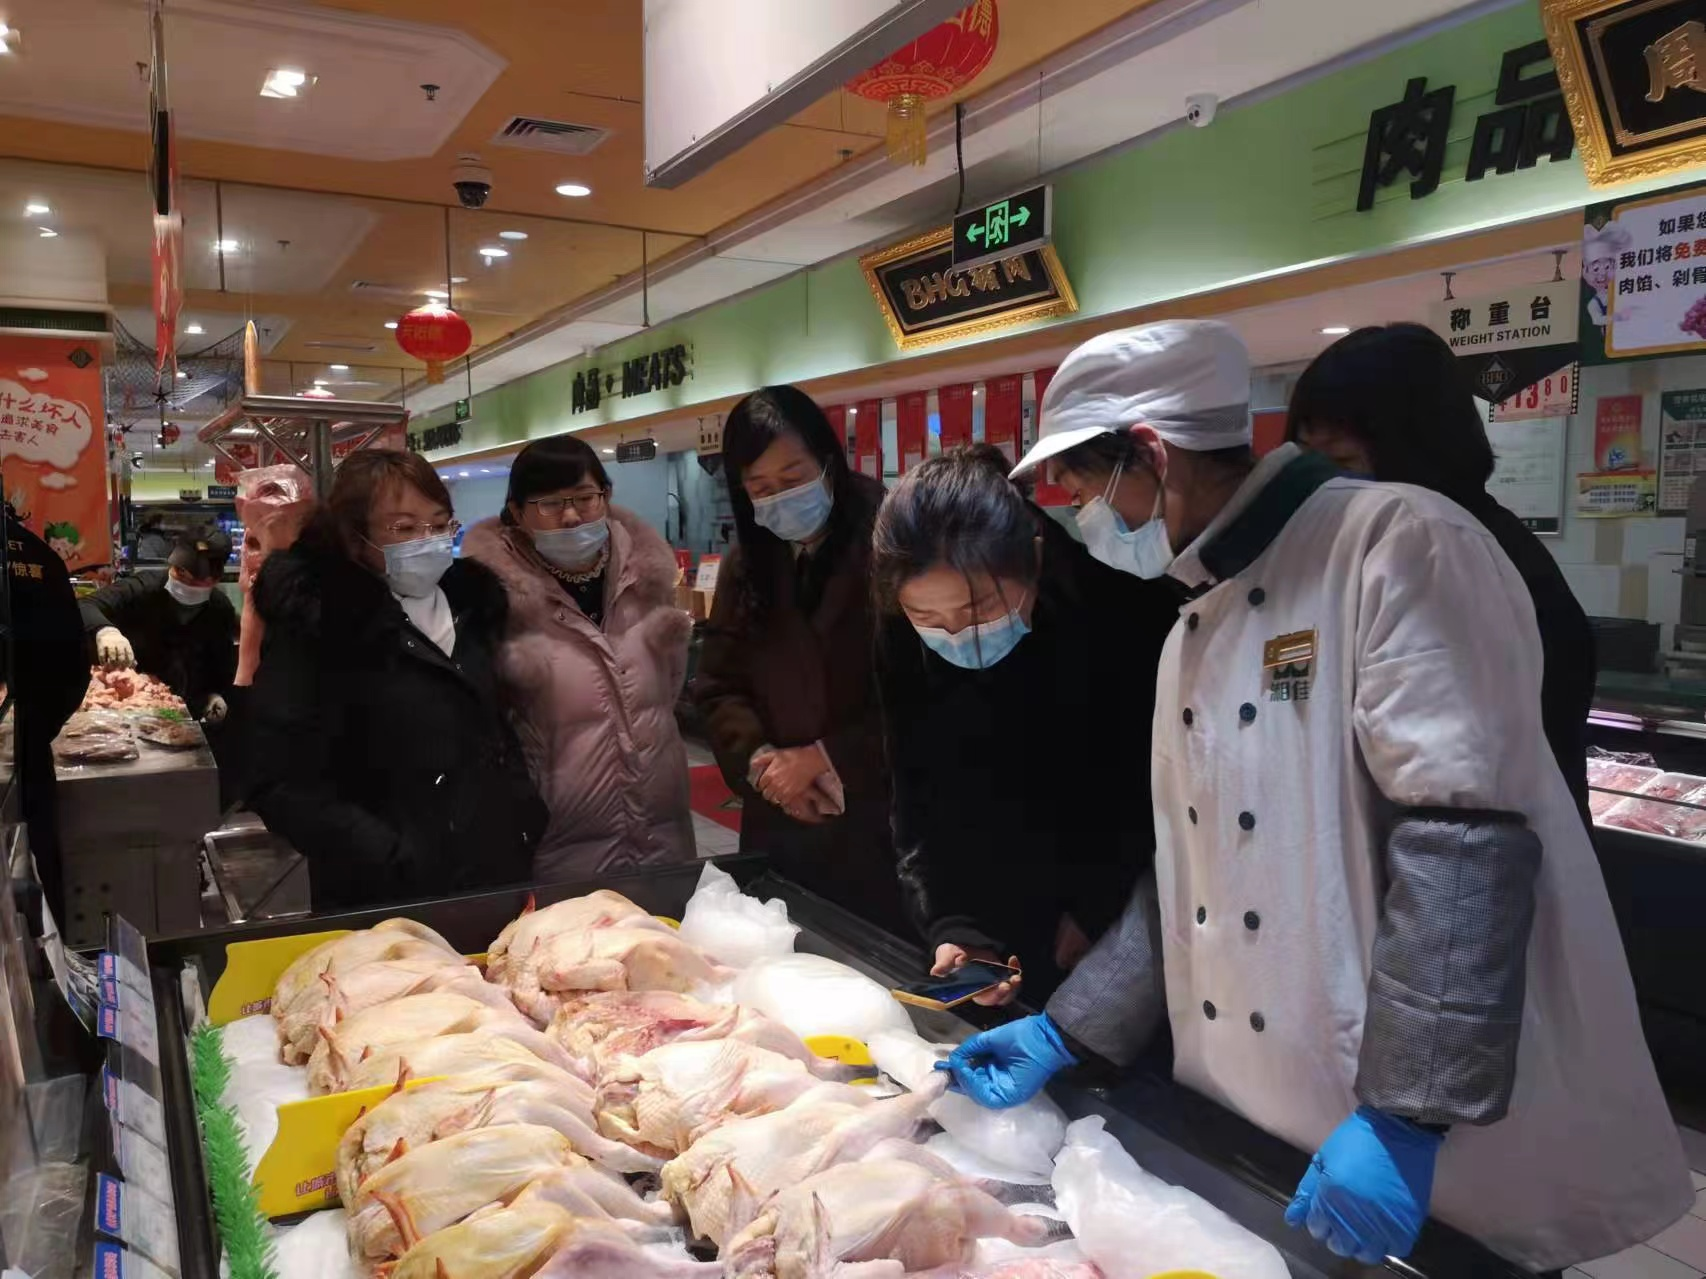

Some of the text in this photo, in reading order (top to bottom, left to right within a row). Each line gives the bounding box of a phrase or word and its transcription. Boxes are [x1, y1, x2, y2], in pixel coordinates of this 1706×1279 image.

[1357, 39, 1575, 212] 肉品
[1450, 296, 1551, 331] 称重台
[1450, 325, 1551, 347] WEIGHT STATION
[622, 344, 687, 399] MEATS
